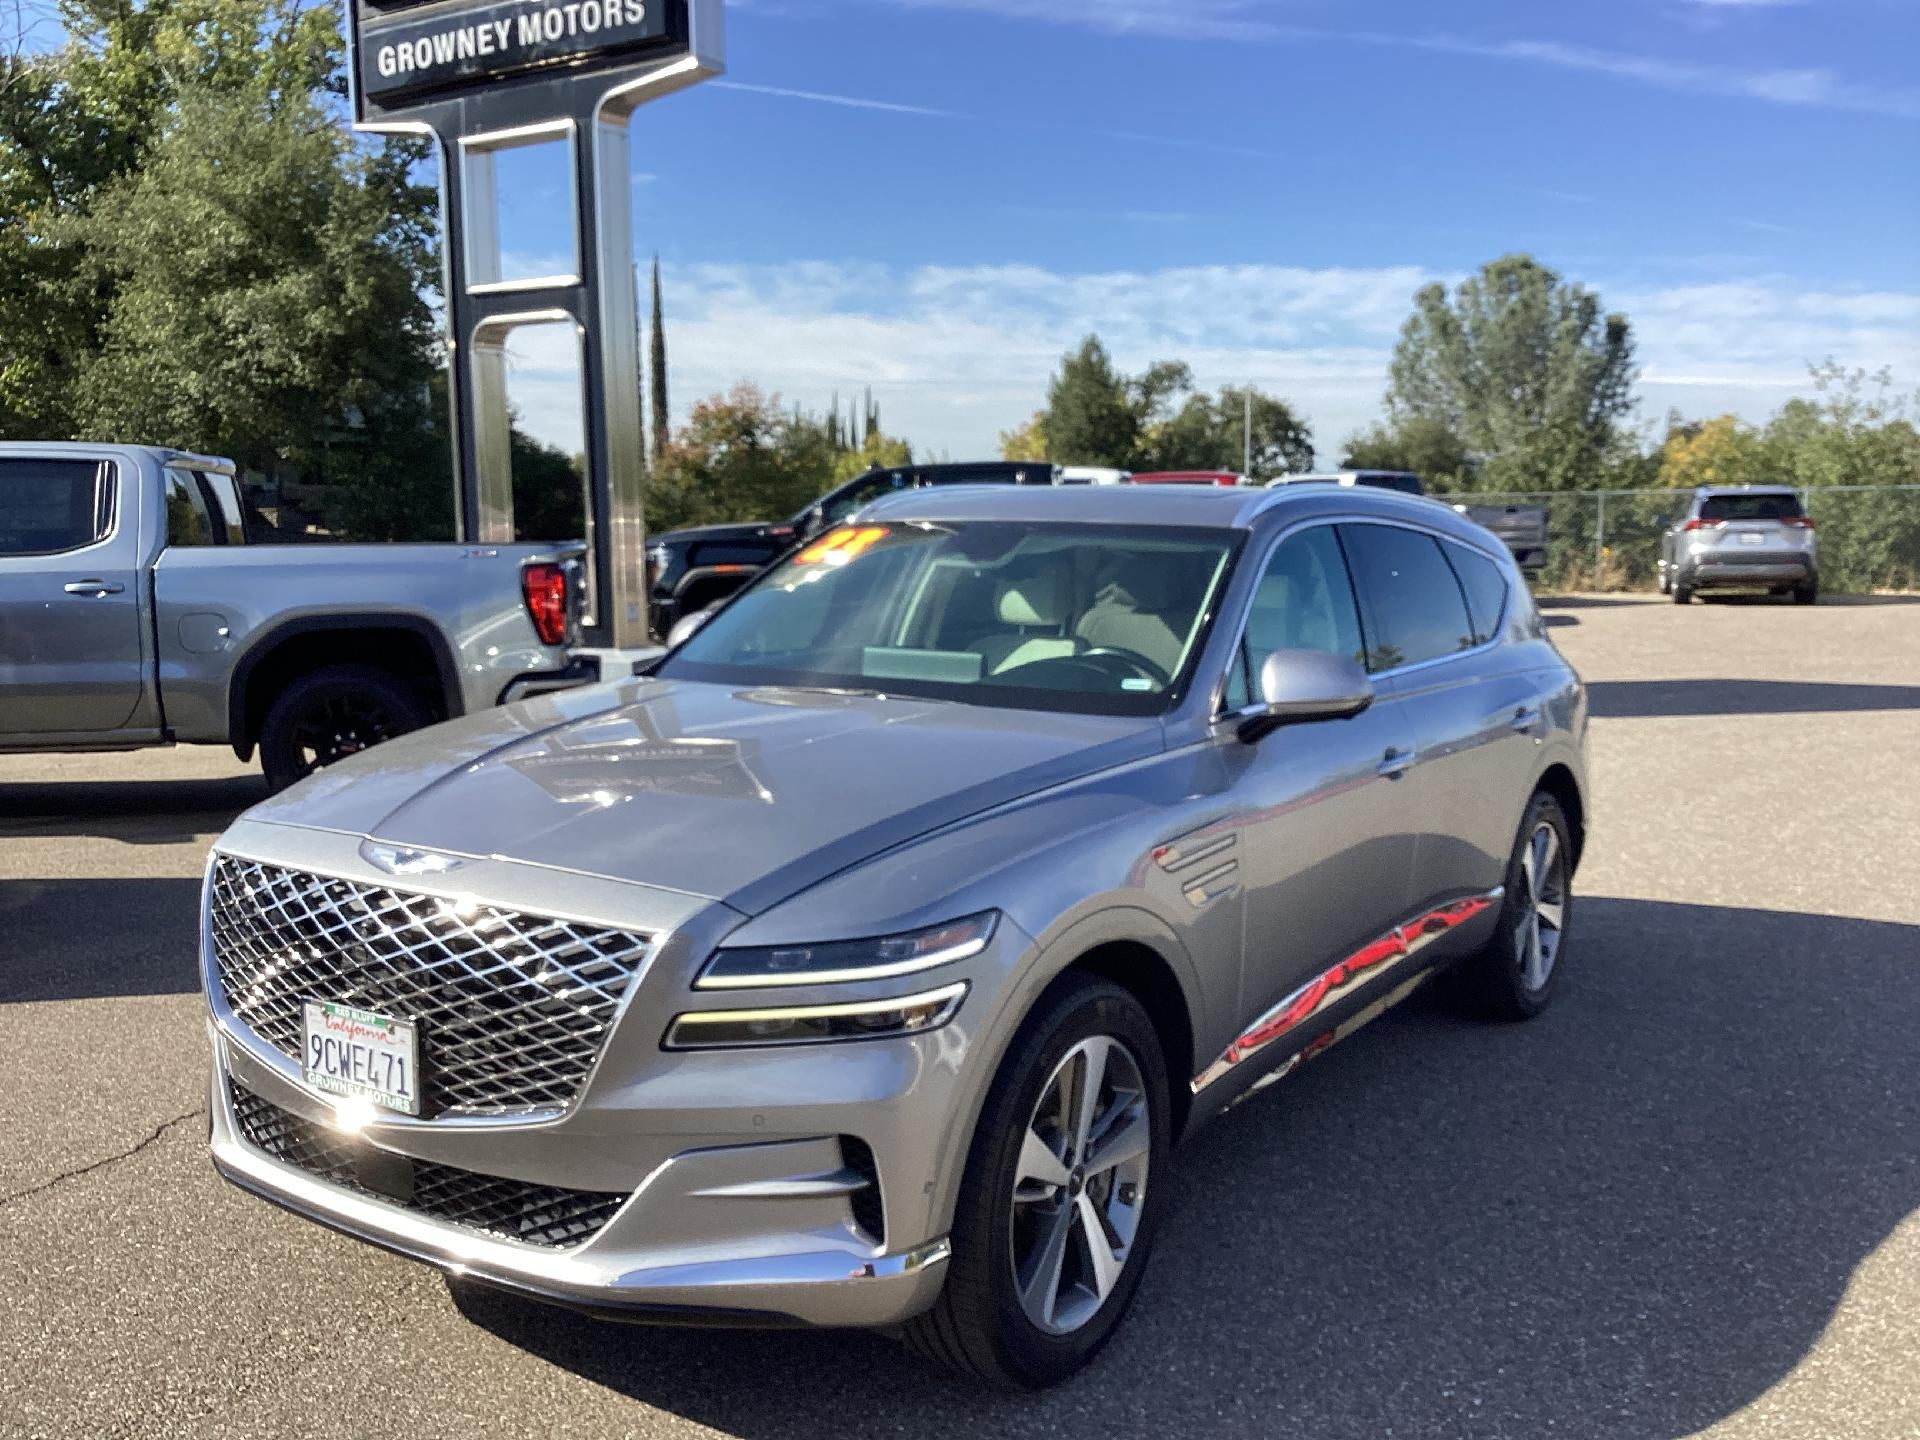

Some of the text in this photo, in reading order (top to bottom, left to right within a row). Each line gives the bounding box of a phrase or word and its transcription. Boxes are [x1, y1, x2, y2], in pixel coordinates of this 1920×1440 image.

[377, 0, 646, 77] GROWNEY MOTORS
[323, 1013, 395, 1044] California
